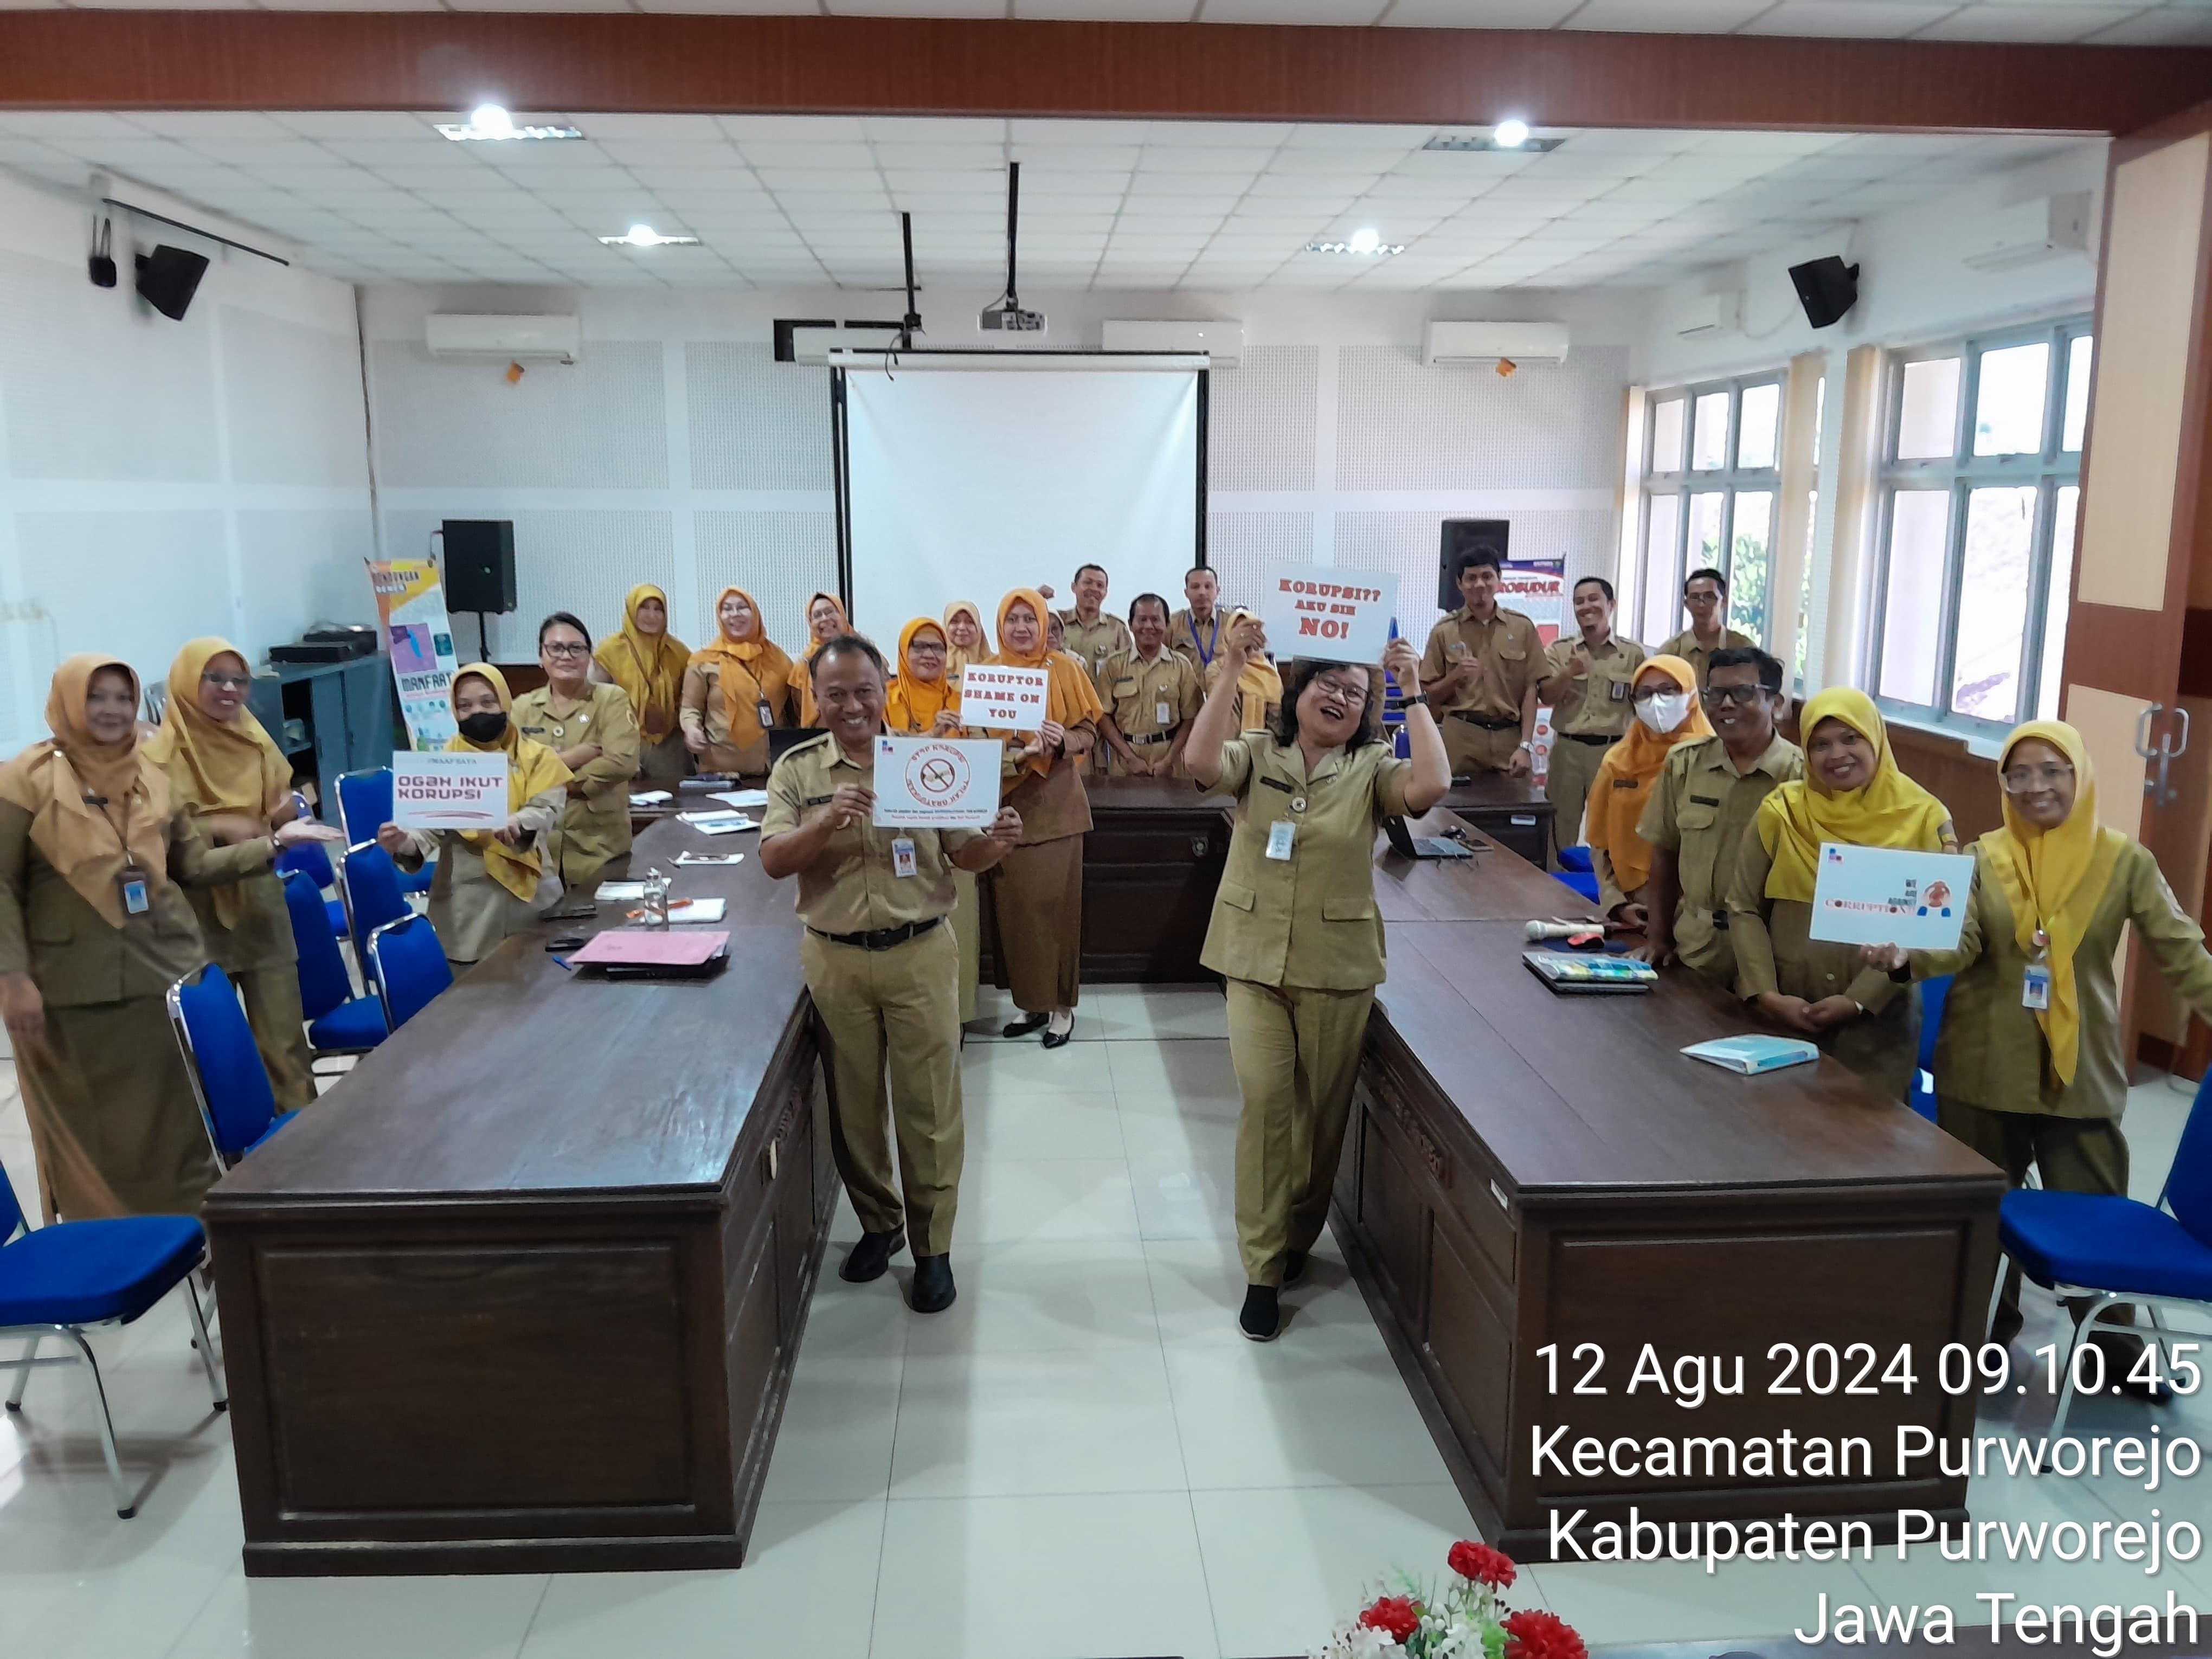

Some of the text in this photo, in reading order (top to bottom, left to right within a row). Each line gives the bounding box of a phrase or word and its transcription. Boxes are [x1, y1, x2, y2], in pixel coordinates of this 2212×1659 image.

[1279, 578, 1381, 602] KORUPSI??
[1496, 581, 1560, 594] ROBUDUR
[1295, 599, 1356, 615] AKU SIH
[1298, 616, 1349, 639] NO!
[968, 671, 1044, 686] KORUPTOR
[964, 689, 1040, 703] SHAME ON
[988, 708, 1017, 719] YOU
[398, 776, 503, 788] OGAH IKUT
[398, 788, 481, 800] KORUPSI
